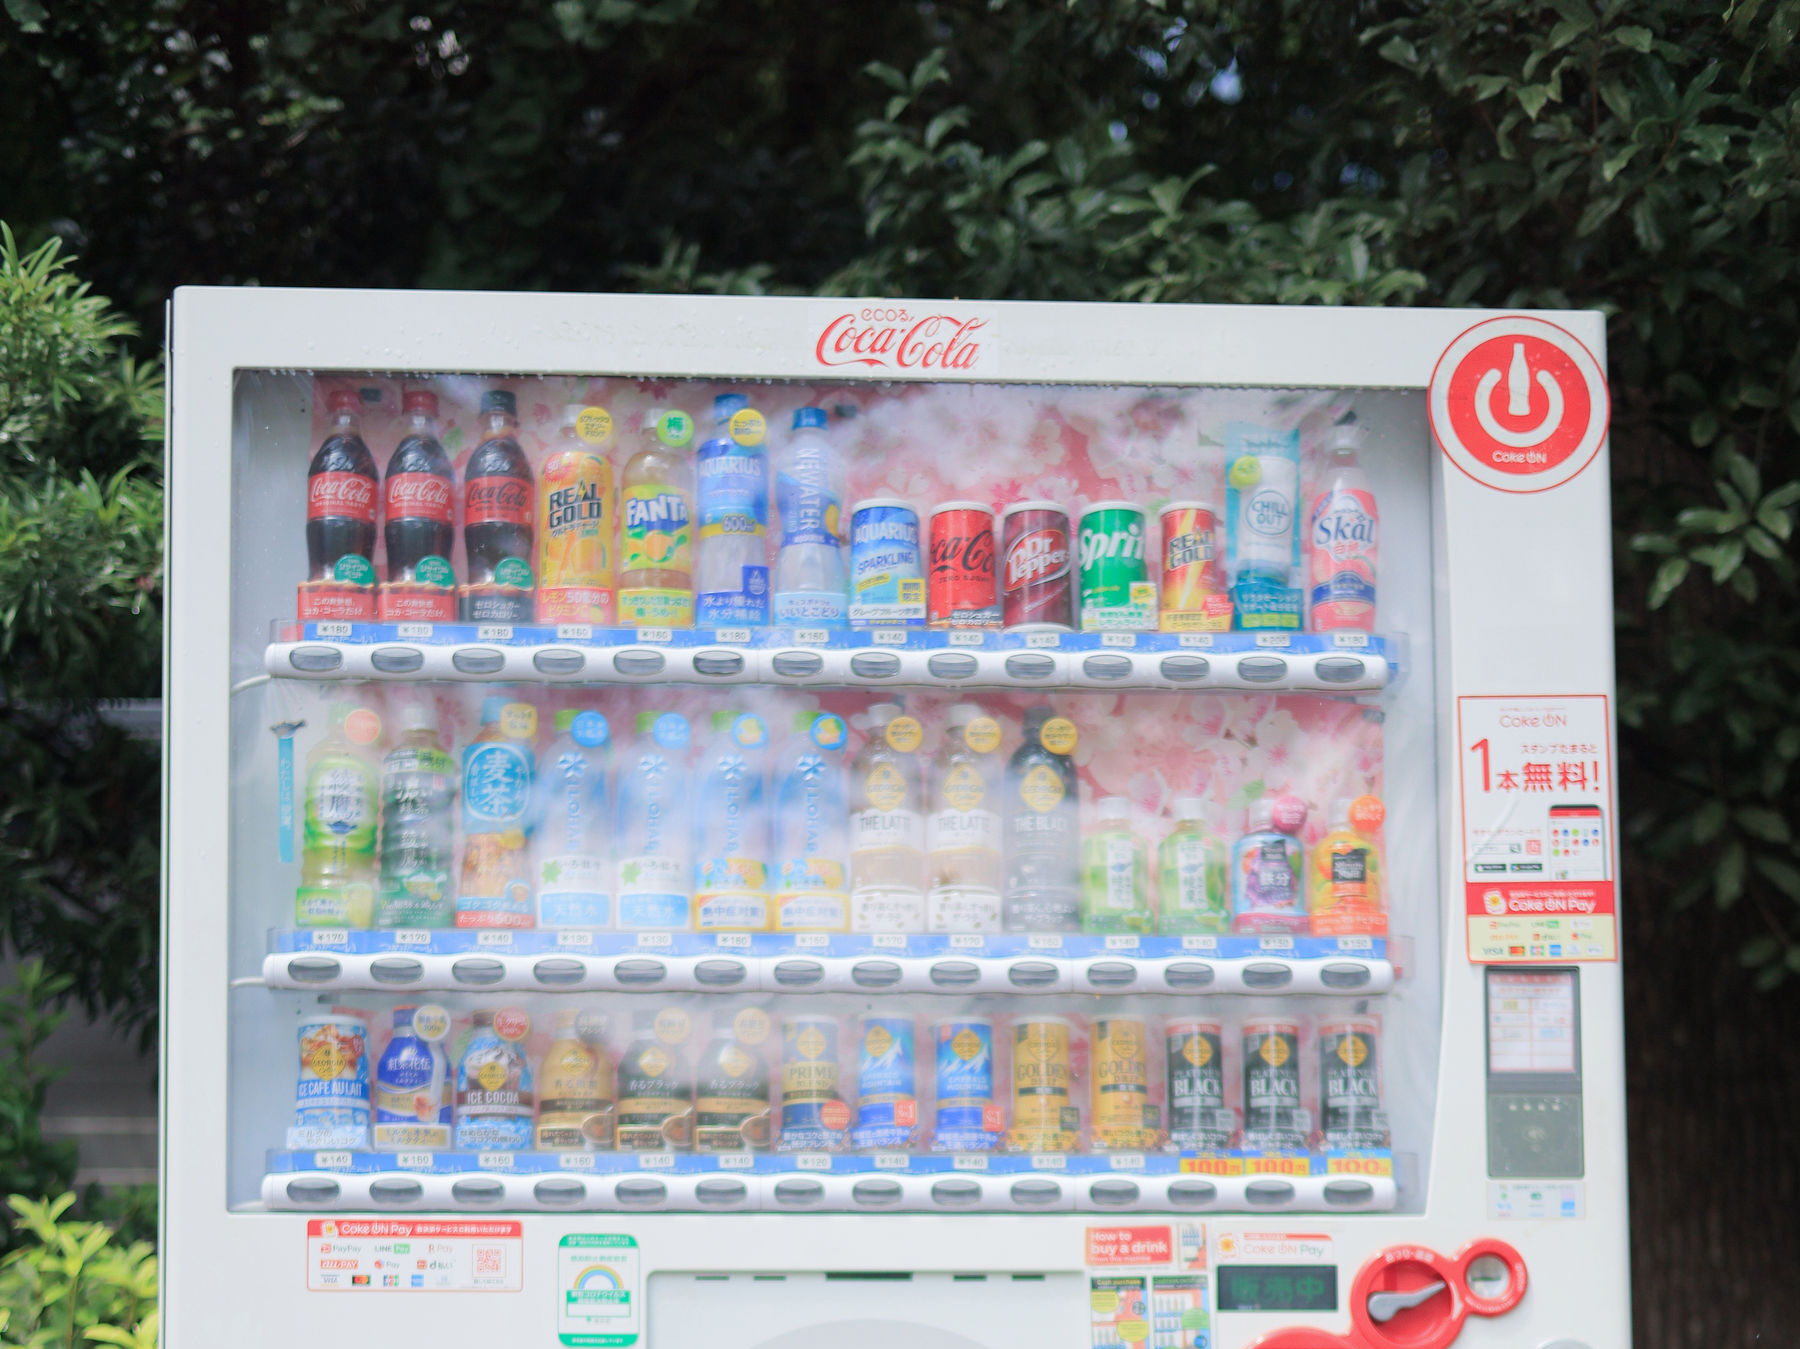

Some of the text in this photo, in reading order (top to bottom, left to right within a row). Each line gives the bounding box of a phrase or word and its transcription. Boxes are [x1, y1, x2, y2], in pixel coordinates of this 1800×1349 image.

[815, 312, 990, 370] Coca-Cola
[1492, 451, 1526, 463] Coke
[549, 480, 602, 511] REAL
[796, 448, 821, 530] NEWATER
[549, 500, 602, 529] GOLD
[625, 493, 690, 529] FANTA
[1251, 500, 1288, 517] CHILL
[1256, 512, 1284, 526] OUT
[1026, 536, 1054, 555] Dr
[1079, 523, 1145, 573] Sprit
[1008, 550, 1068, 585] Pepper
[1500, 712, 1567, 728] Coke ON
[1520, 743, 1598, 755] スタンプたまると
[1470, 737, 1600, 793] 1本無料!
[481, 750, 514, 815] 麦茶
[1509, 896, 1596, 913] Coke ON Pay
[387, 1057, 432, 1072] 紅茶花伝
[467, 1091, 520, 1105] ICE COCOA
[341, 1221, 413, 1237] Coke ON Pay
[1091, 1230, 1133, 1242] How to
[332, 1244, 362, 1255] PayPay
[374, 1244, 393, 1254] LINE
[1091, 1241, 1168, 1256] buy a drink
[1243, 1243, 1275, 1255] Coke
[1300, 1243, 1325, 1258] Pay
